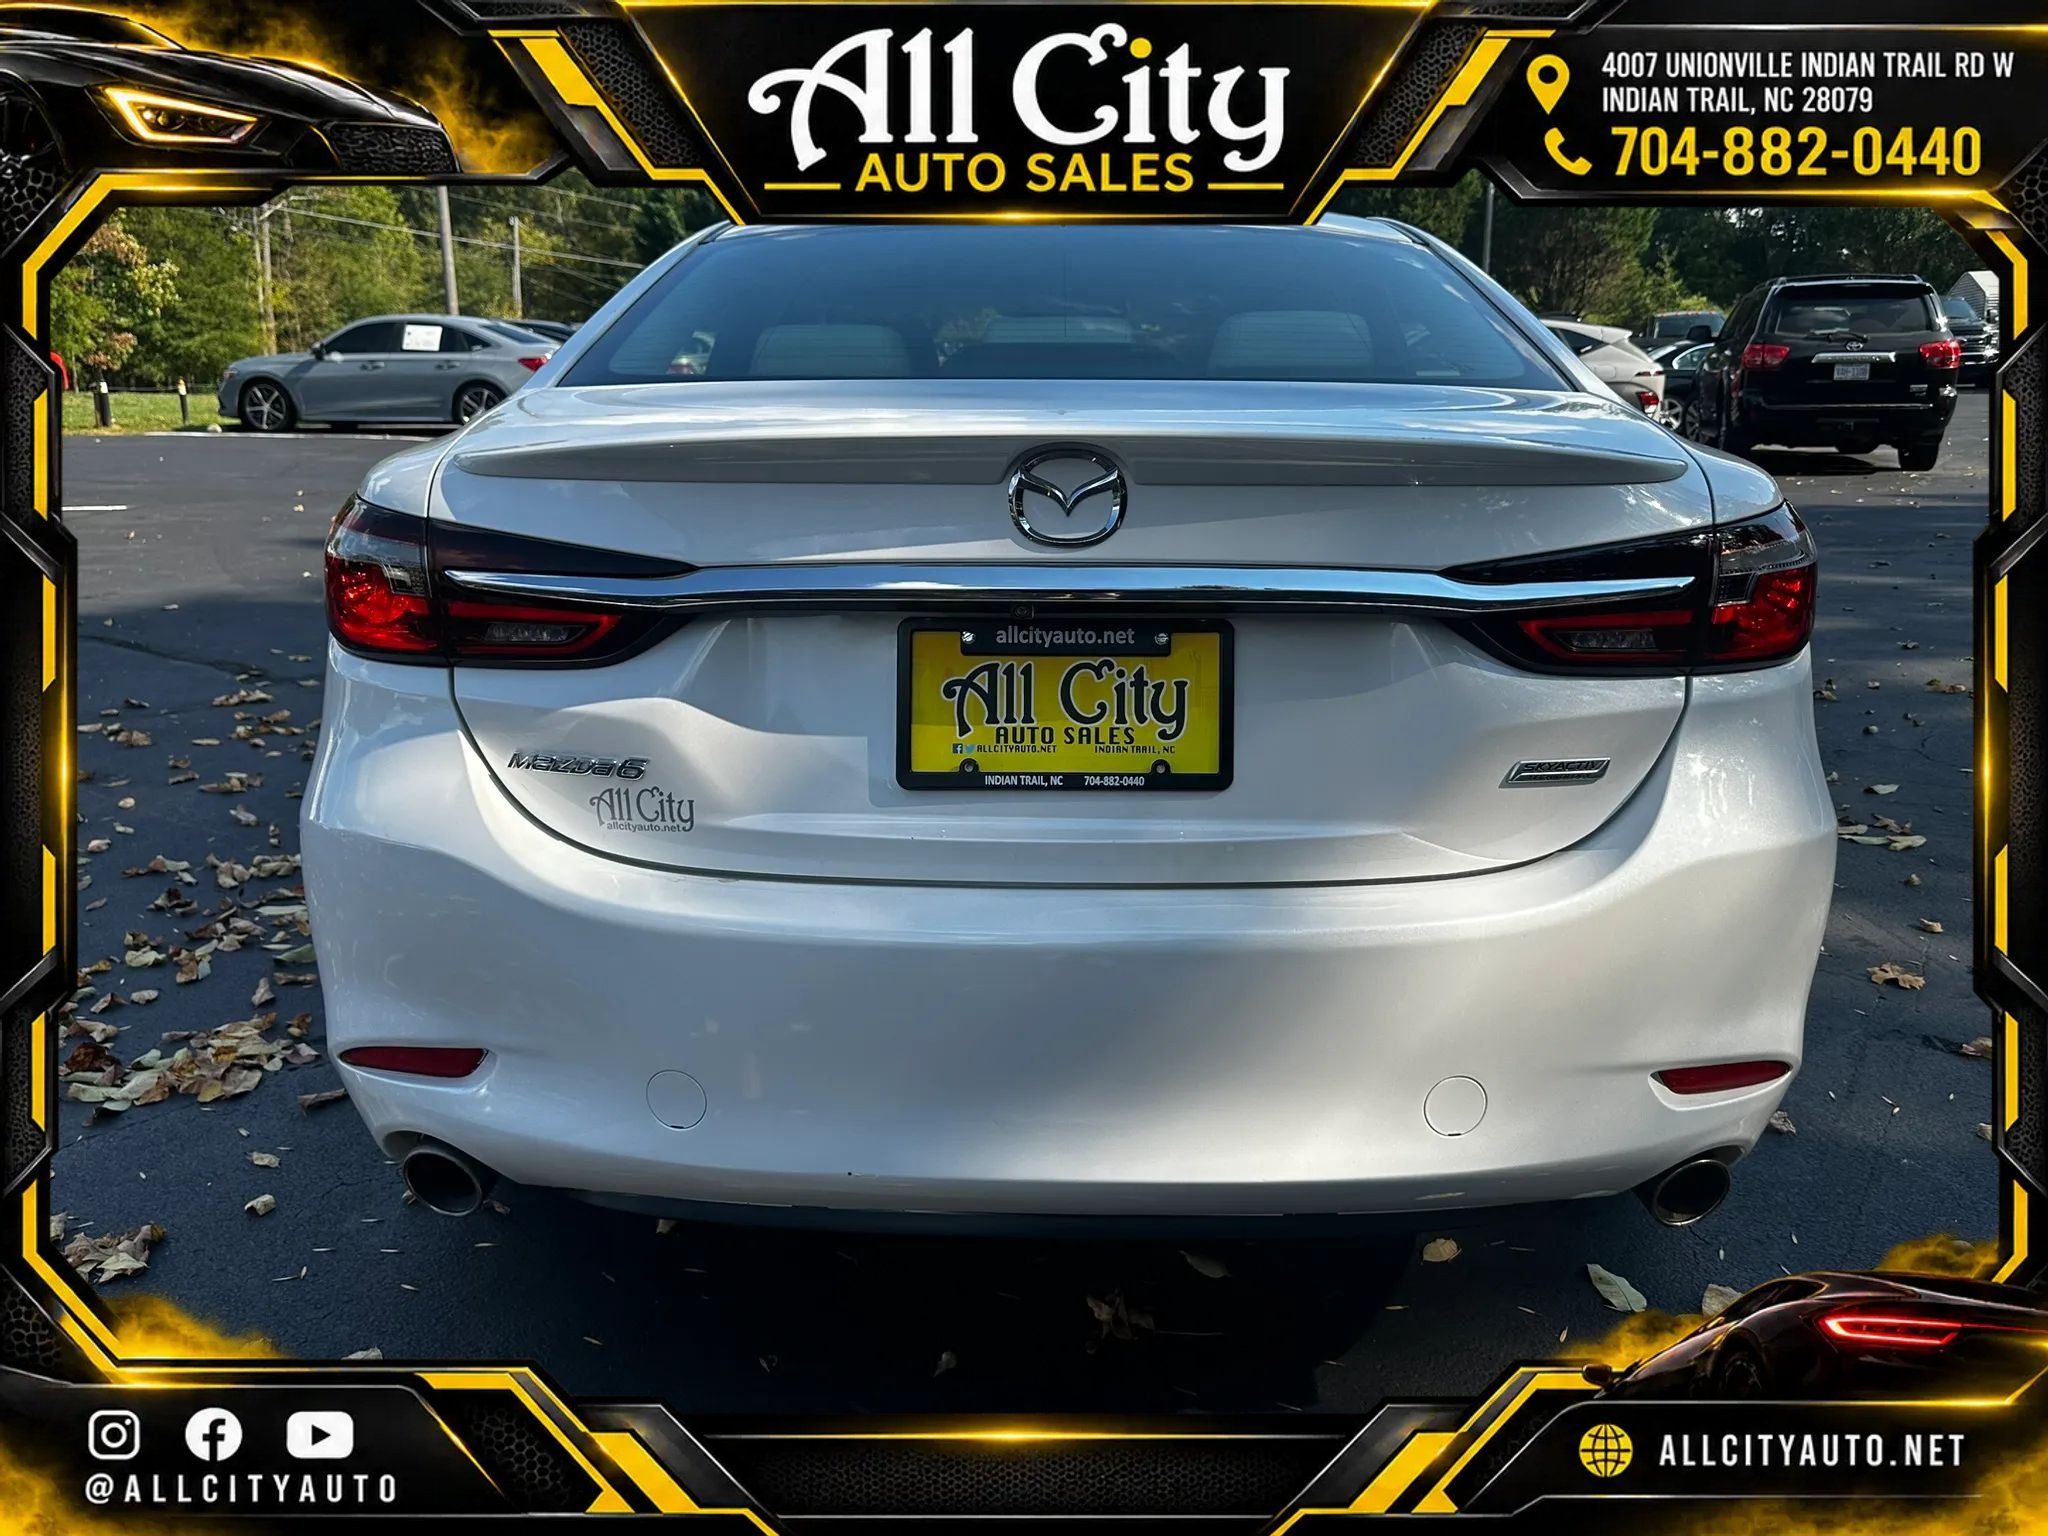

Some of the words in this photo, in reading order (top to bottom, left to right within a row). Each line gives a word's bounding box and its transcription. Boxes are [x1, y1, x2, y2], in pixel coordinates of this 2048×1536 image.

[996, 625, 1135, 648] allcityauto.net
[942, 660, 1035, 738] All
[1059, 657, 1188, 740] City
[995, 727, 1054, 745] AUTO
[1064, 727, 1134, 745] SALES
[976, 744, 1057, 754] ALLCITYAUTO.NET
[1094, 745, 1128, 754] INDIAN
[1130, 745, 1160, 755] TRAIL,
[1163, 745, 1176, 754] NC
[1523, 761, 1600, 772] SKYACTIV
[984, 775, 1018, 786] INDIAN
[1020, 775, 1048, 787] TRAIL,
[1050, 775, 1063, 786] NC
[1084, 775, 1145, 787] 704-882-0440
[589, 787, 633, 827] All
[636, 786, 695, 832] City
[607, 822, 681, 833] allcityauto.net
